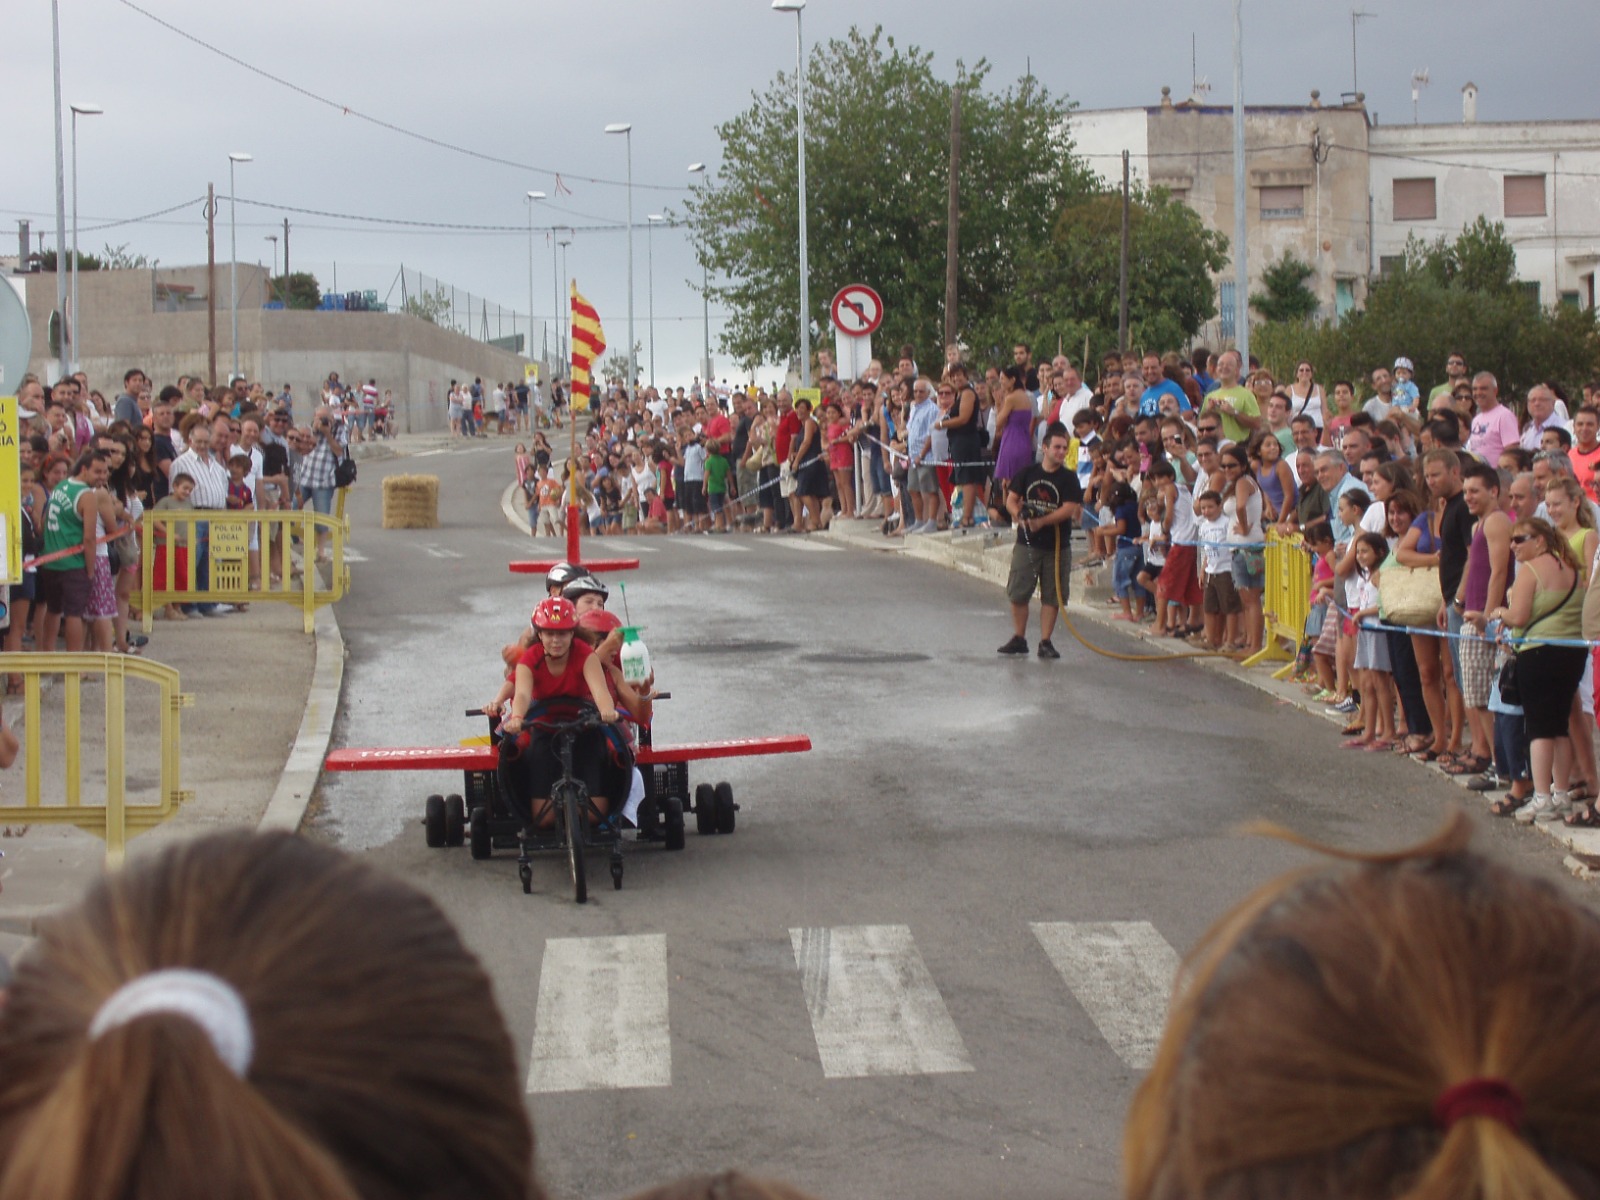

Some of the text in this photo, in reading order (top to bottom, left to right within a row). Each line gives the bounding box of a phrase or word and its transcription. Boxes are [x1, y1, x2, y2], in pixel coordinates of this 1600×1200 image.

[0, 435, 15, 446] IA
[47, 503, 60, 531] 5
[216, 533, 239, 541] LOCAL
